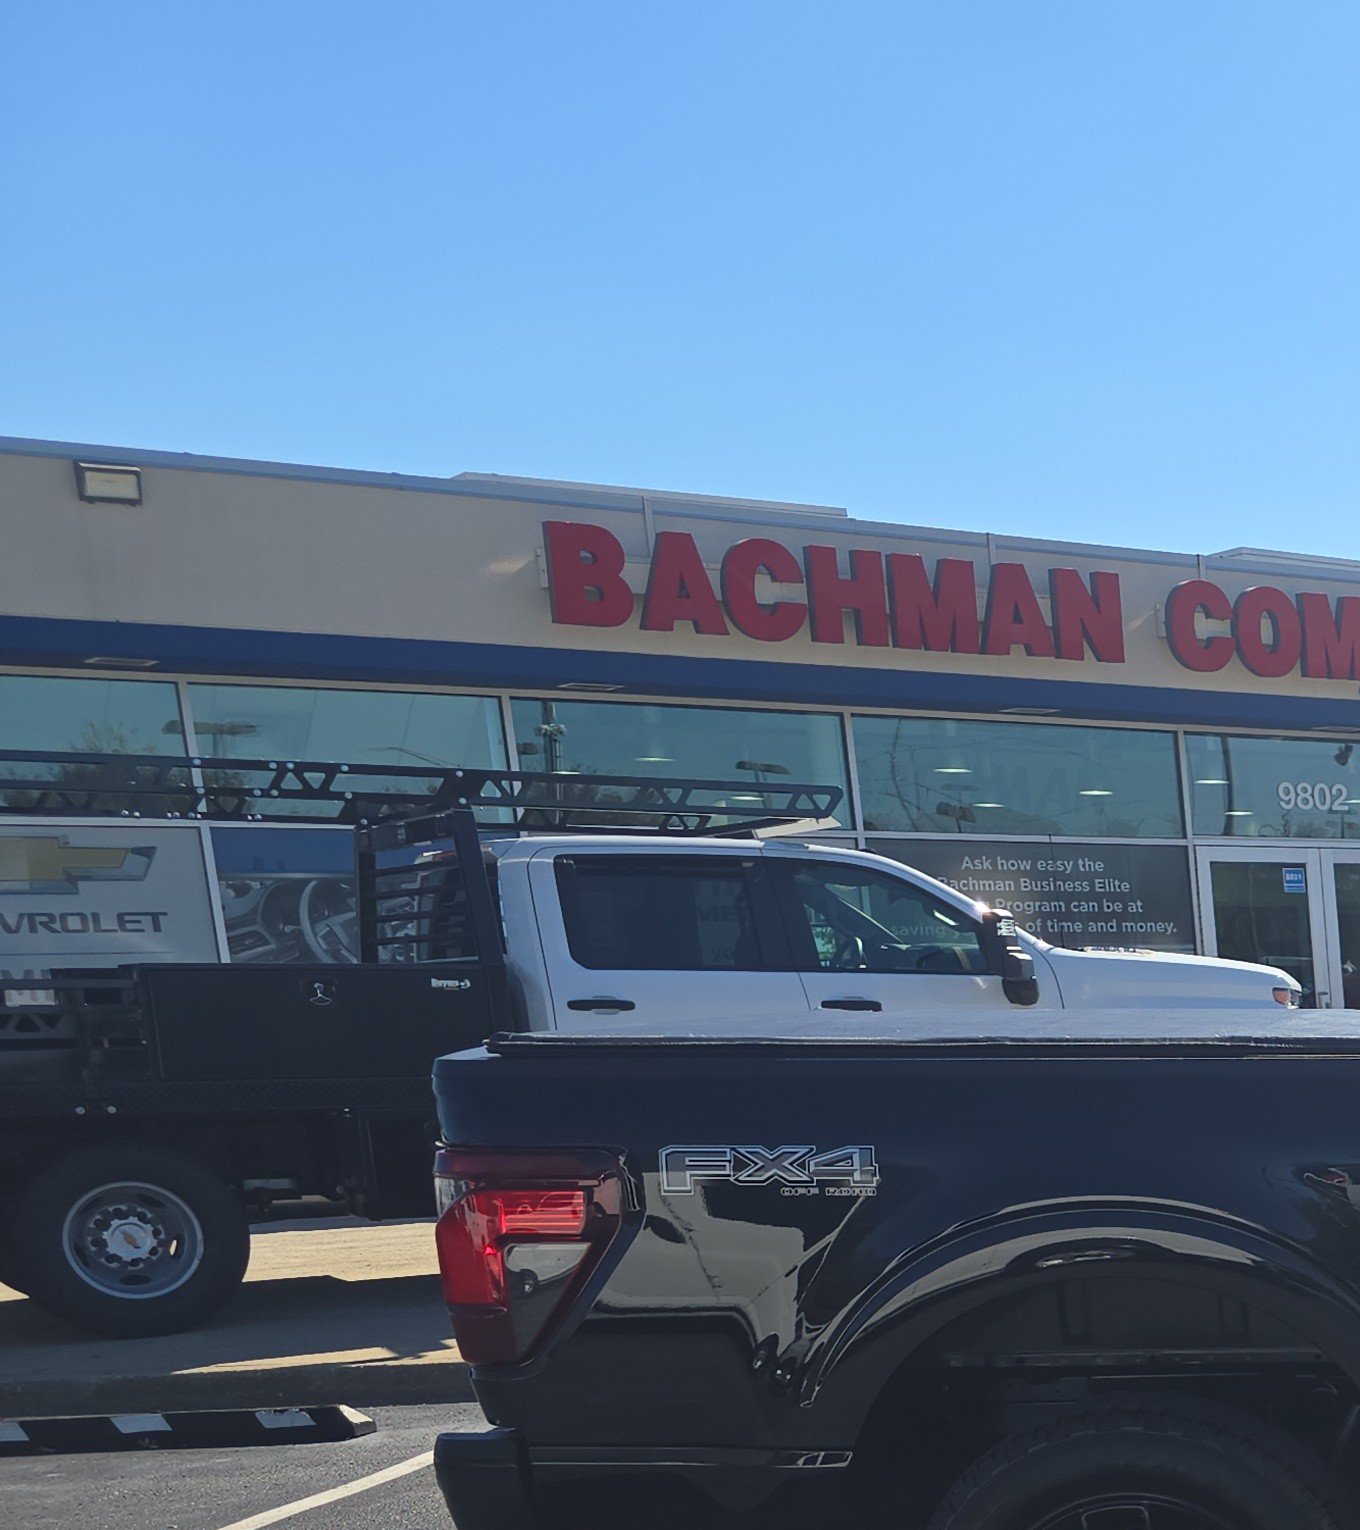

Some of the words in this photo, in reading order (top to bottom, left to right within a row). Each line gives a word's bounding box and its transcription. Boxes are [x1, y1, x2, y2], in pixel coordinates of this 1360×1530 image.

[542, 520, 1125, 663] BACHMAN
[1278, 781, 1349, 811] 9802
[961, 856, 992, 870] Ask
[997, 856, 1031, 871] how
[1036, 859, 1073, 874] easy
[1077, 857, 1104, 872] the
[1020, 878, 1089, 893] Business
[1095, 878, 1130, 893] Elite
[995, 899, 1065, 915] Program
[1071, 901, 1098, 913] can
[1103, 899, 1122, 913] be
[1127, 900, 1143, 913] at
[1026, 918, 1043, 932] of
[1047, 919, 1082, 933] time
[1086, 919, 1117, 933] and
[1122, 922, 1177, 938] money.
[659, 1145, 879, 1195] FX4
[780, 1186, 819, 1196] OFF
[825, 1186, 877, 1196] ROAD
